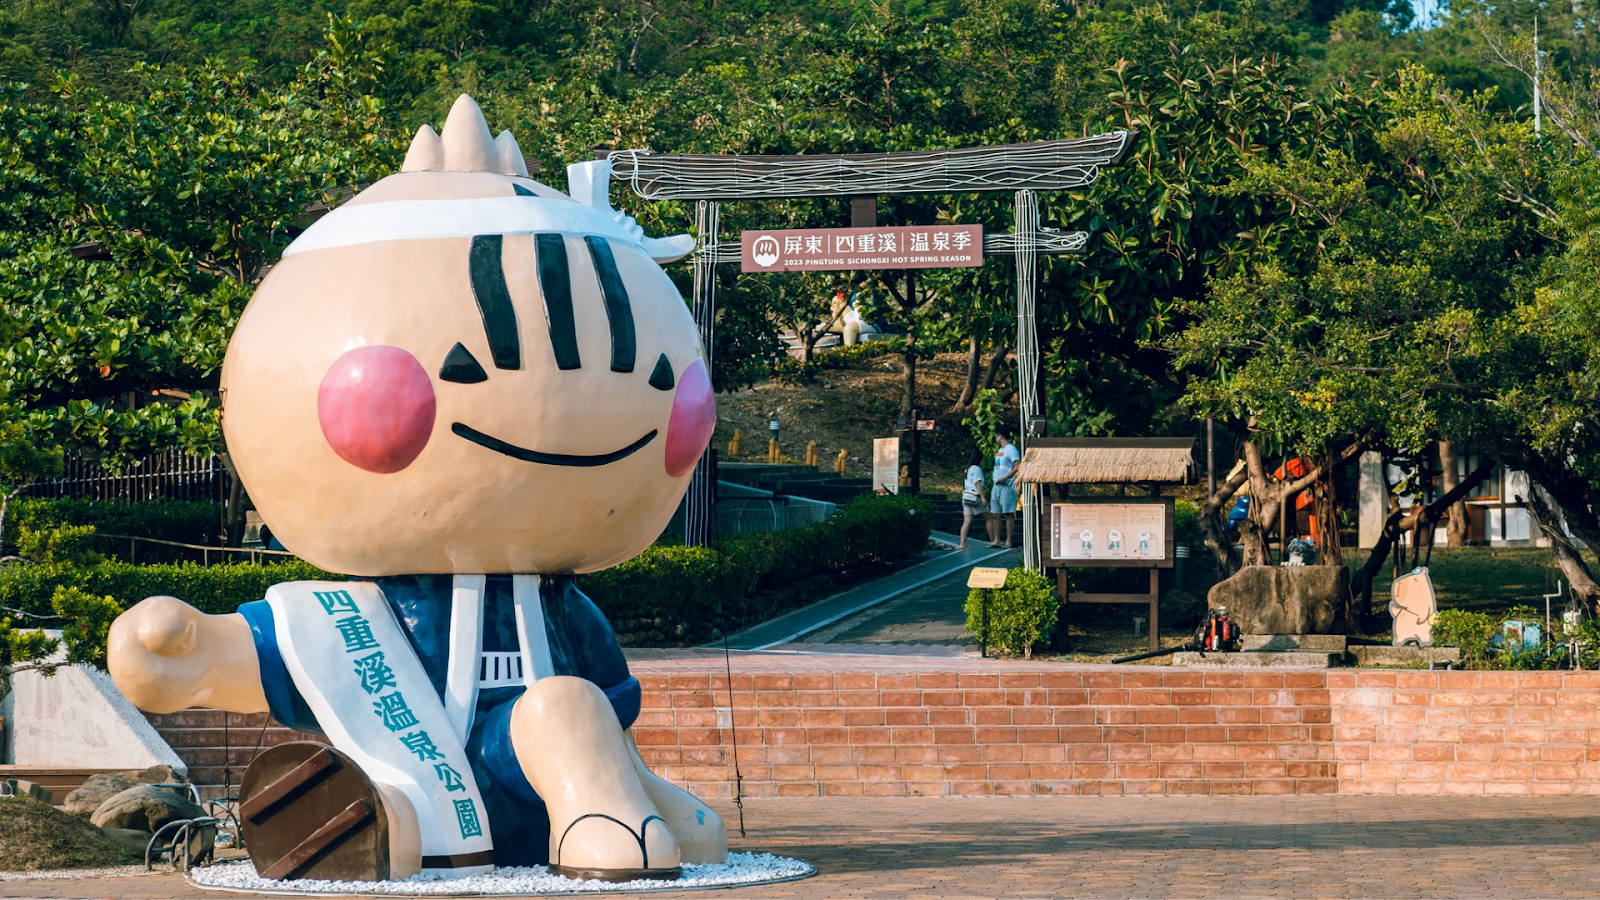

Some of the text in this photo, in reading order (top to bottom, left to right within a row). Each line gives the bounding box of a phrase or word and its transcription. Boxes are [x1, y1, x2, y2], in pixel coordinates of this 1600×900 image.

[783, 230, 972, 255] 屏東 四重溪 温泉季
[783, 254, 972, 266] 2023 PINGTUNG SICHONGXI HOT SPRING SEASON
[312, 589, 483, 840] 四重溪溫泉公園
